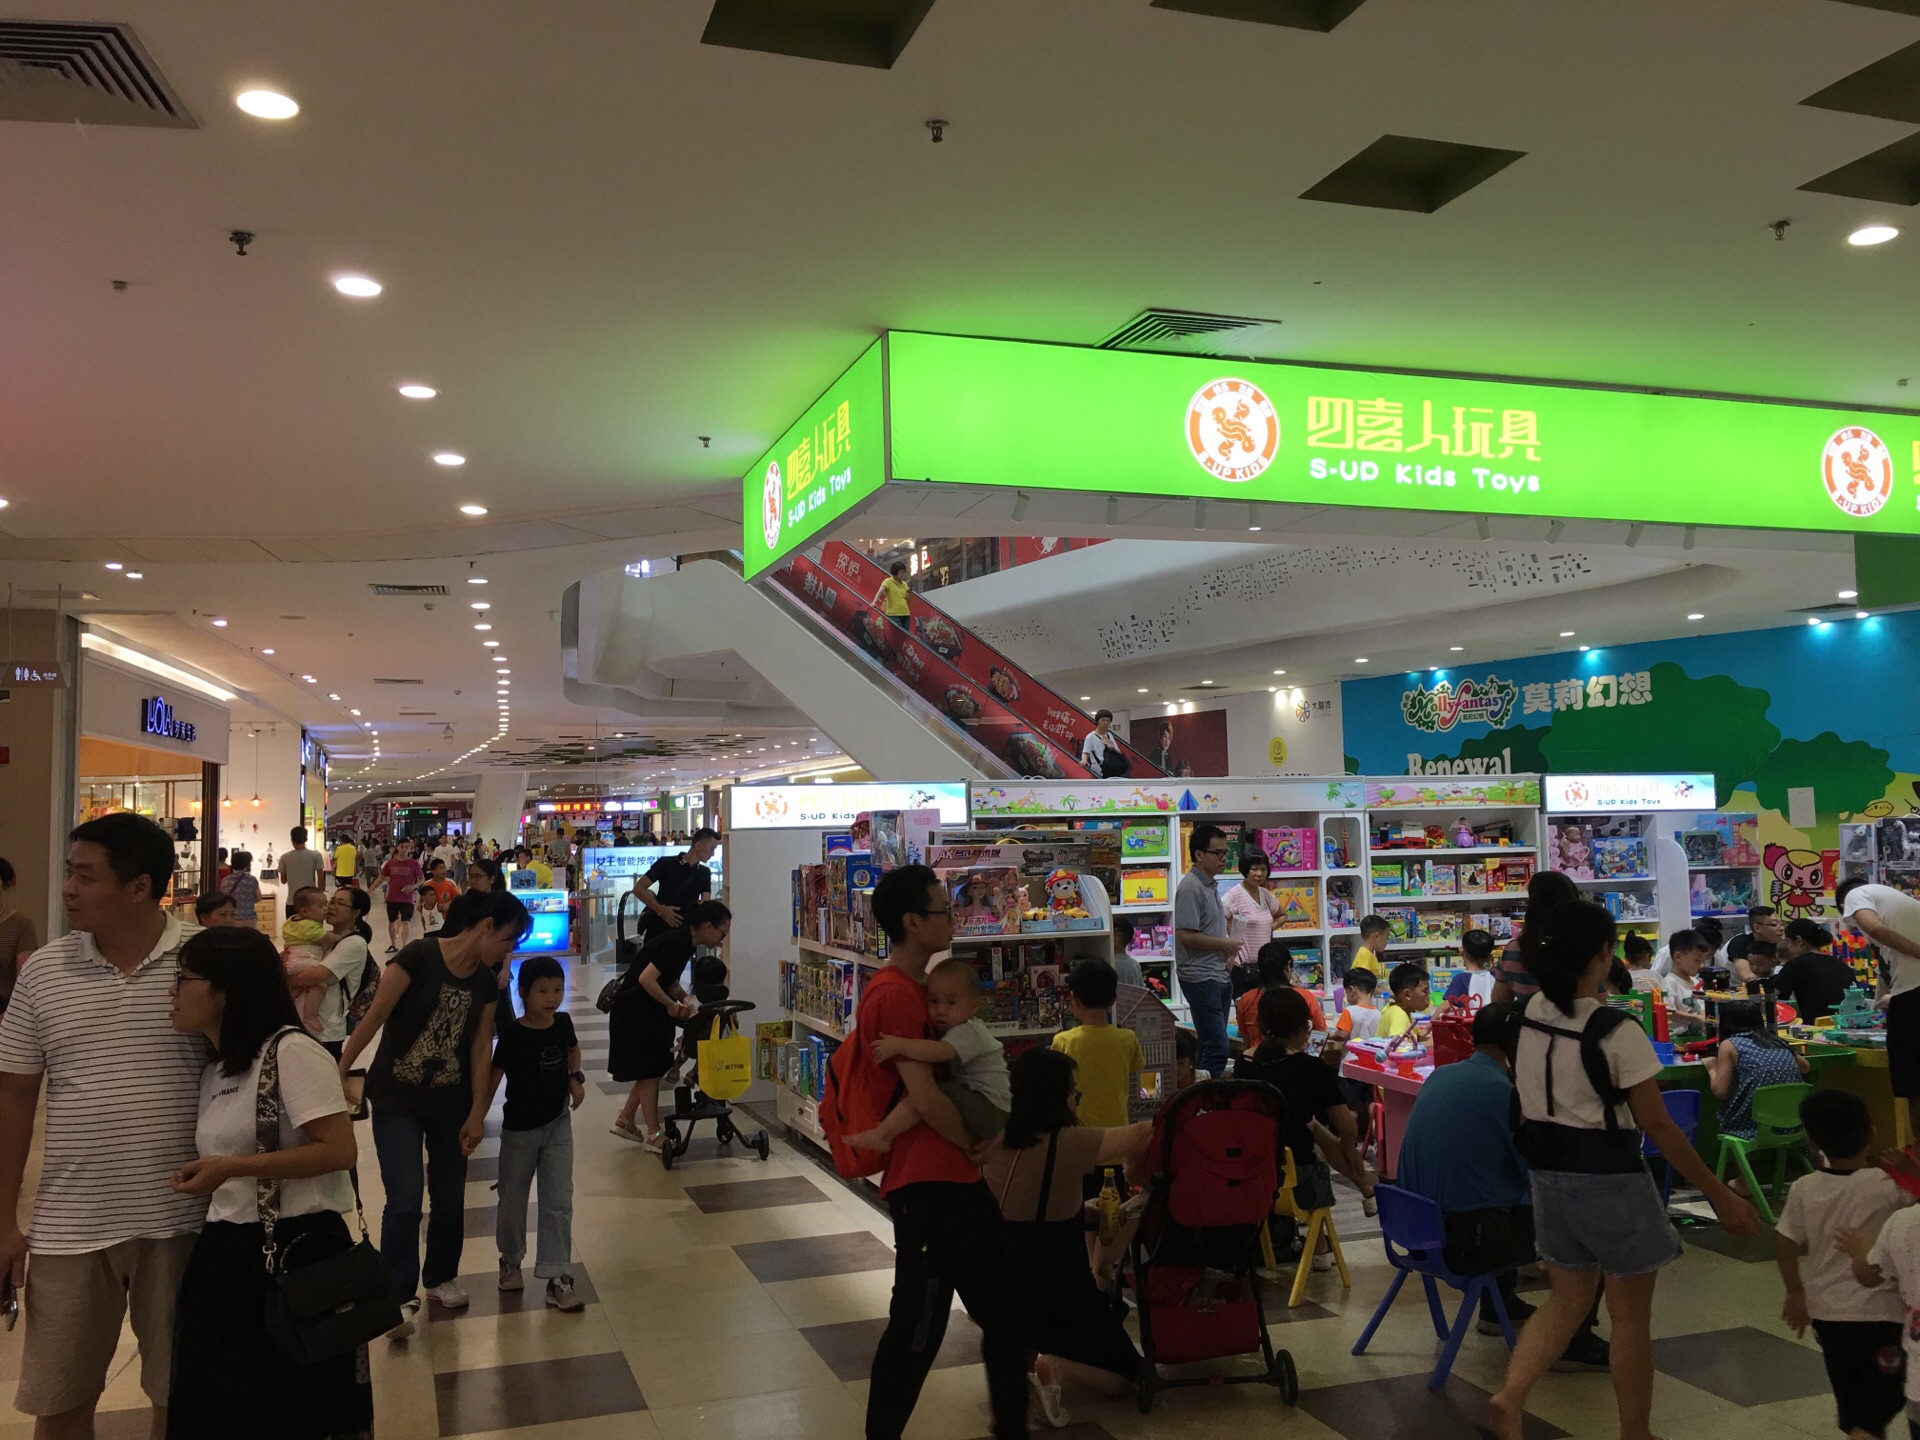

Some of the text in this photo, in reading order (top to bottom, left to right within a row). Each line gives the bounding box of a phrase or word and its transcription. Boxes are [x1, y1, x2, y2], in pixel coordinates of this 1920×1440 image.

[1306, 396, 1542, 462] 四喜人玩具
[786, 399, 851, 501] 四喜人玩具
[808, 486, 826, 513] Kids
[829, 467, 852, 496] Toys
[1395, 463, 1457, 488] Kids
[1472, 467, 1541, 493] Toys
[1522, 671, 1653, 715] 莫莉幻想
[1462, 712, 1485, 721] 莫莉幻想
[1407, 747, 1512, 775] Renewal
[832, 811, 856, 820] Kids
